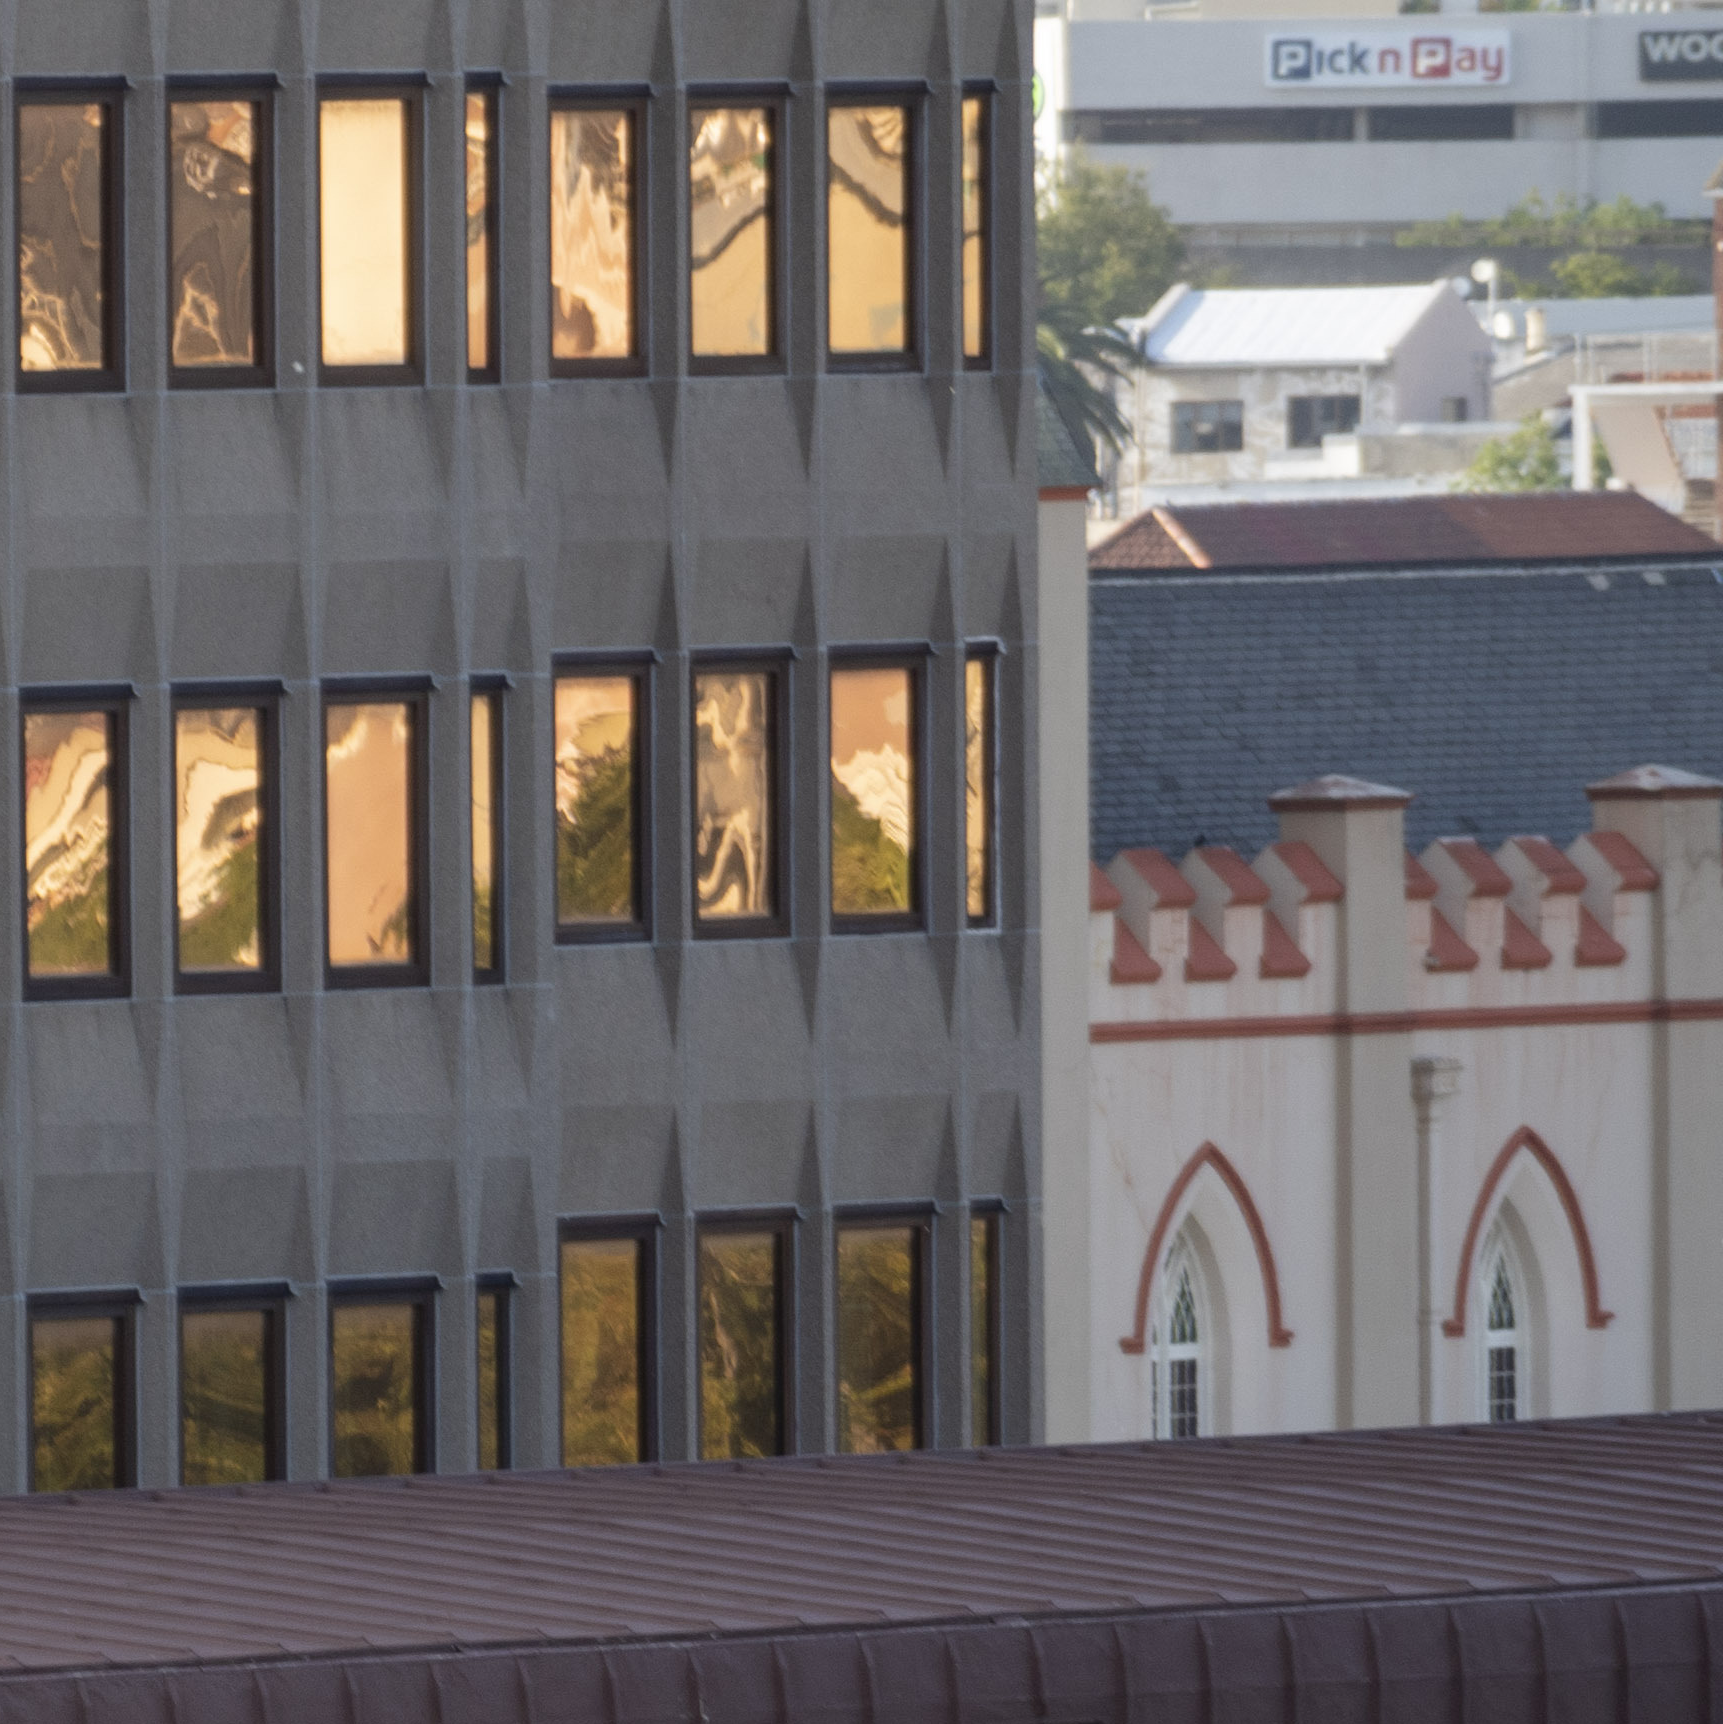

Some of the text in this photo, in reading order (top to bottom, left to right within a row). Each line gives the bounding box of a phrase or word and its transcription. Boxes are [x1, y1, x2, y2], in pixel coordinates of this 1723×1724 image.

[1273, 37, 1504, 81] Pick n Pay
